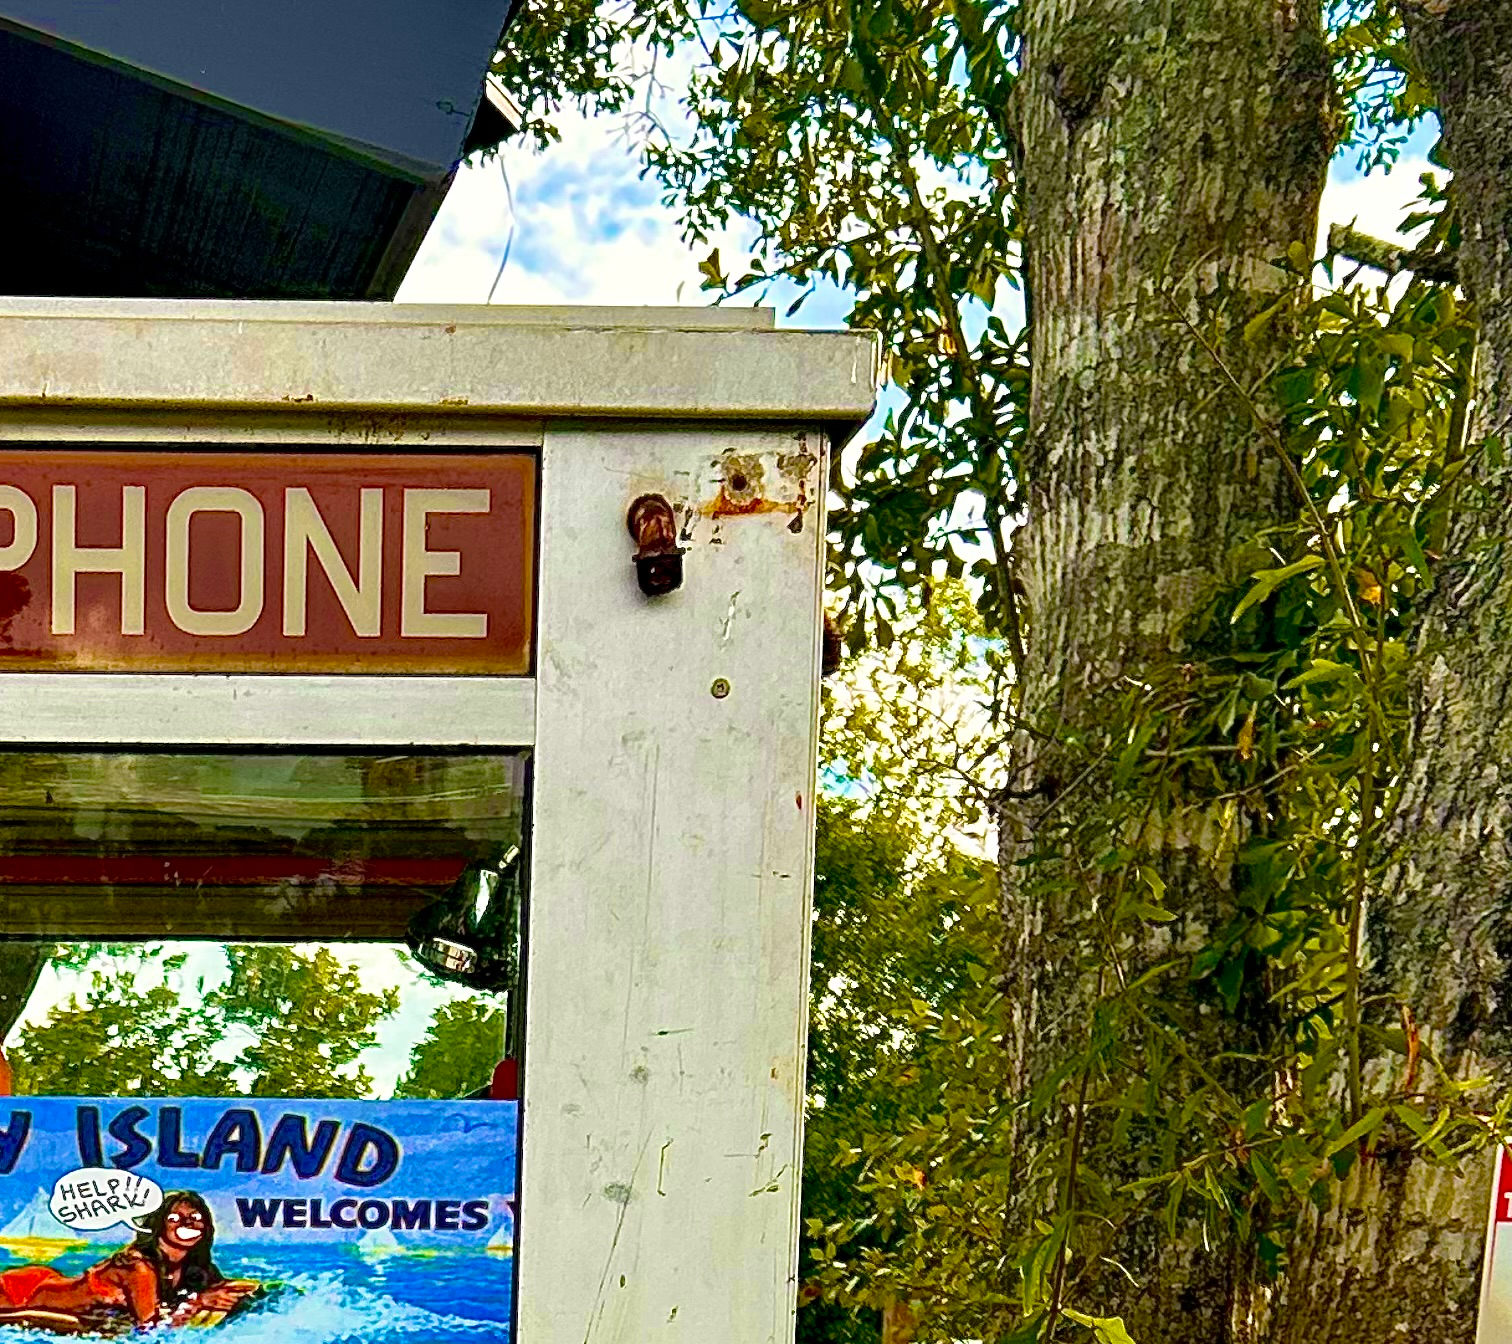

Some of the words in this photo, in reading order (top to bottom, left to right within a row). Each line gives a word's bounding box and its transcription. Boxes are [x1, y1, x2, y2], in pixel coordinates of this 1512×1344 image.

[76, 1105, 401, 1187] ISLAND
[60, 1176, 144, 1201] HELP!!
[236, 1198, 489, 1231] WELCOMES
